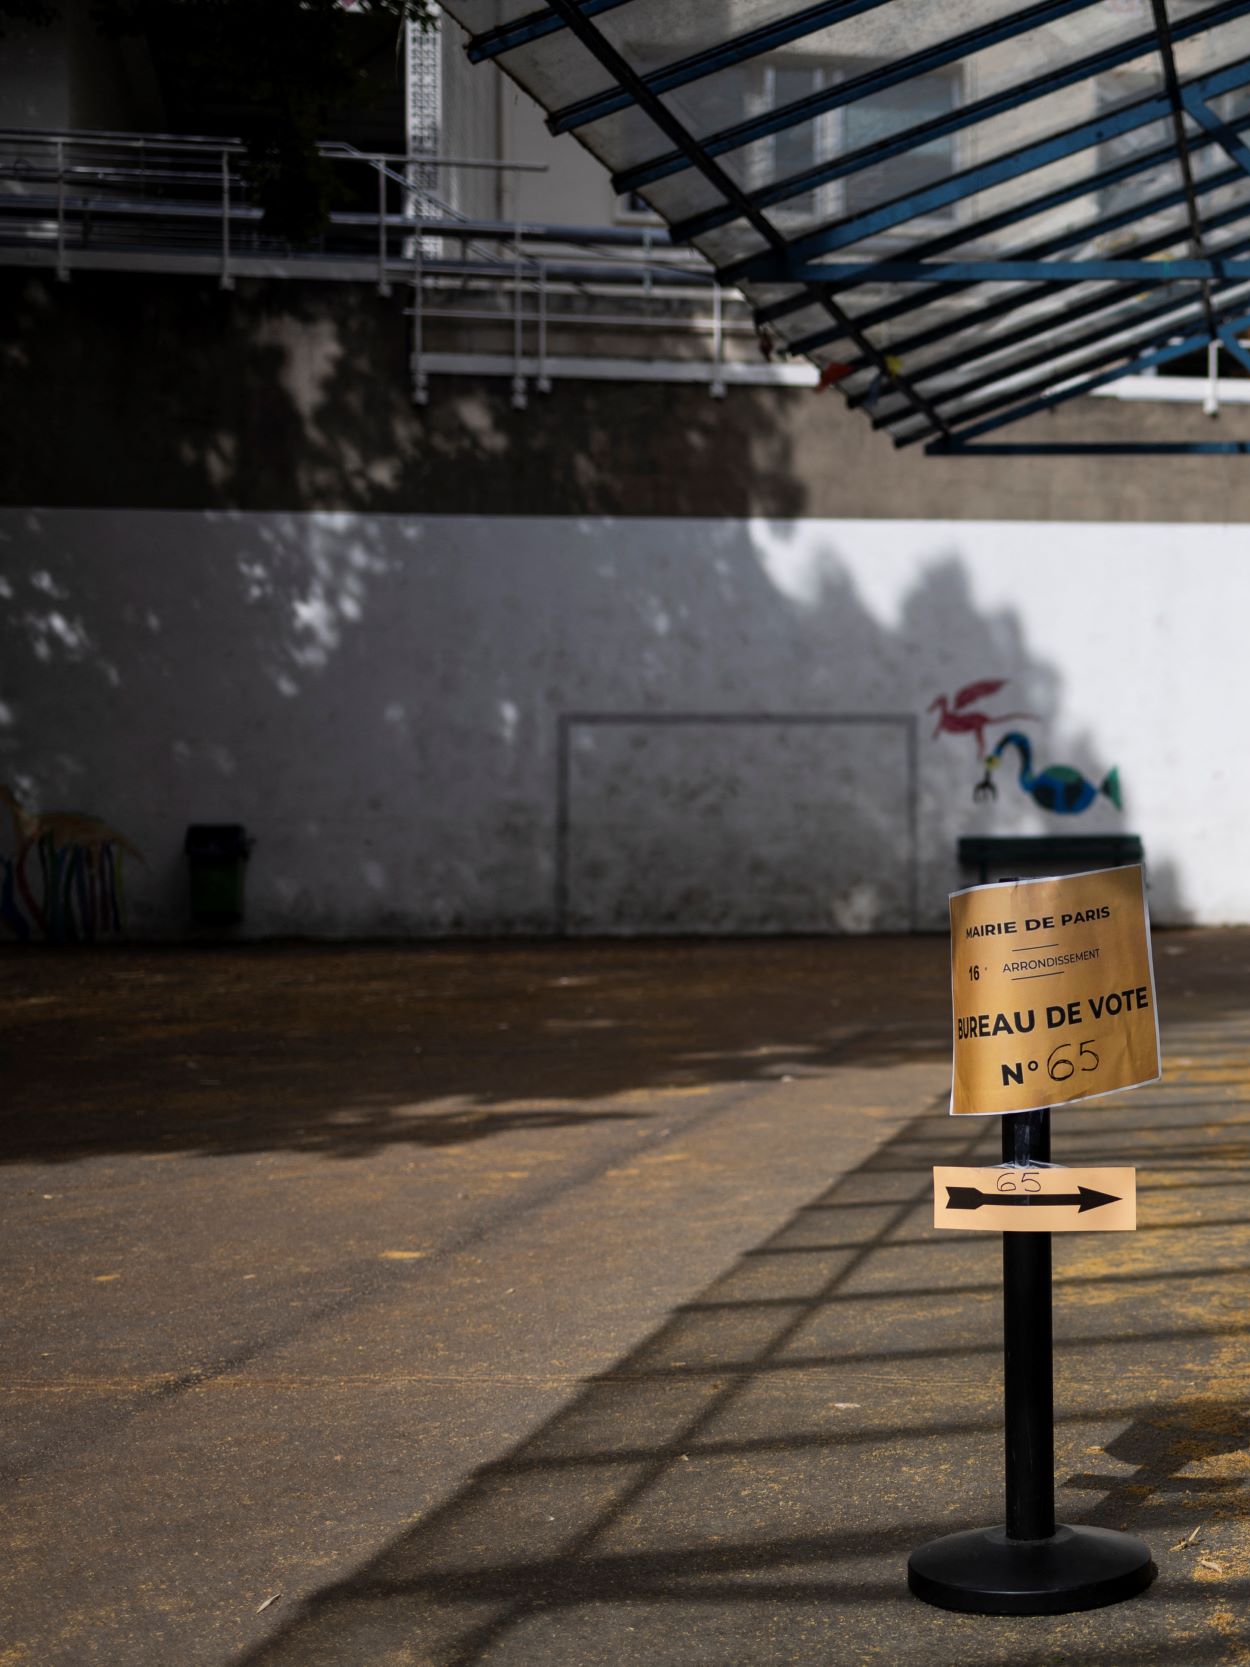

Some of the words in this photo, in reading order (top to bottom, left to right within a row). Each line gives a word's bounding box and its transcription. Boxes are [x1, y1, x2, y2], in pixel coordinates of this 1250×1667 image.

[966, 921, 1017, 938] MAIRIE
[1025, 916, 1055, 931] DE
[1060, 906, 1110, 927] PARIS
[1002, 948, 1100, 972] ARRONDISSEMENT
[958, 1009, 1034, 1040] BUREAU
[1046, 1002, 1082, 1028] DE
[1088, 986, 1149, 1020] VOTE
[1001, 1060, 1038, 1086] N°
[1047, 1040, 1100, 1082] 65
[996, 1172, 1042, 1192] 65
